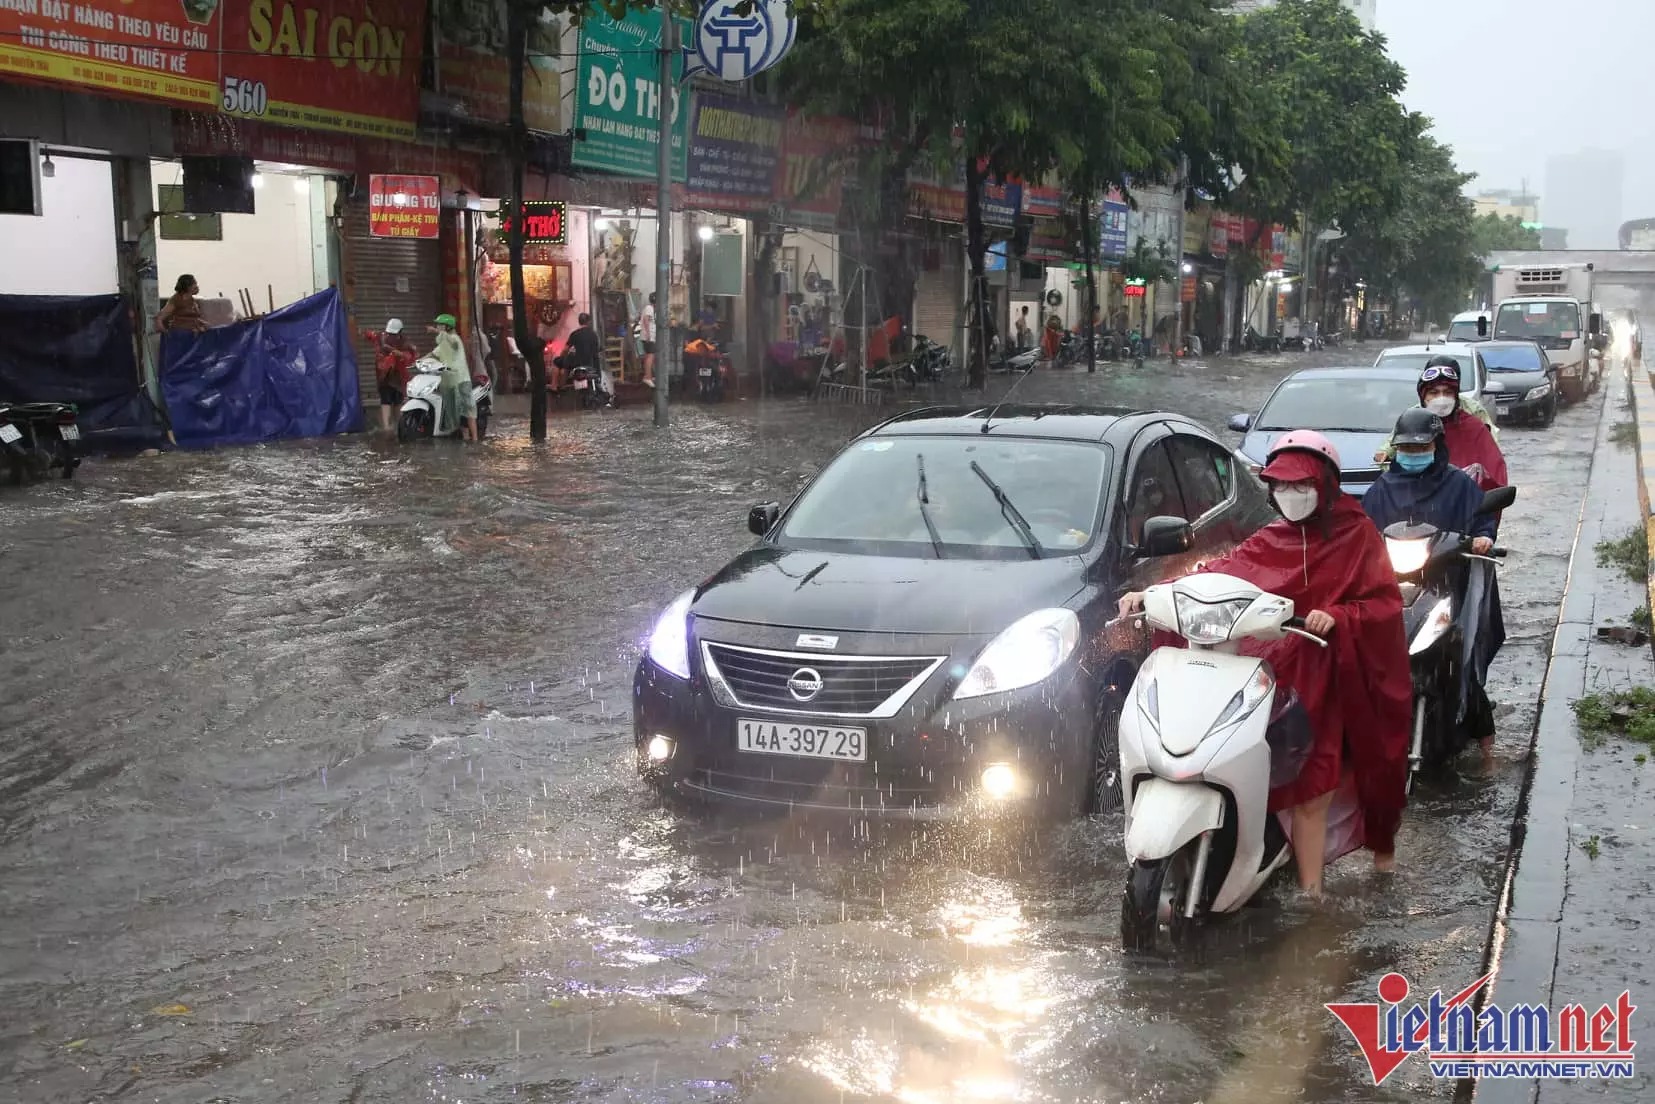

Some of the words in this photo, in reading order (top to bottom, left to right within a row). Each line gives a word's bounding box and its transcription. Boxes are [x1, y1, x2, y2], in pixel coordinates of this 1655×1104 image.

[74, 5, 114, 30] HÀNG
[118, 14, 152, 38] THEO
[155, 22, 179, 44] YÊU
[328, 4, 405, 76] GÒN
[94, 40, 128, 63] THEO
[170, 52, 187, 73] KẾ
[223, 76, 267, 115] 560
[588, 58, 627, 112] ĐỒ
[789, 680, 820, 690] NISSAN
[744, 723, 862, 757] 14A-397.29
